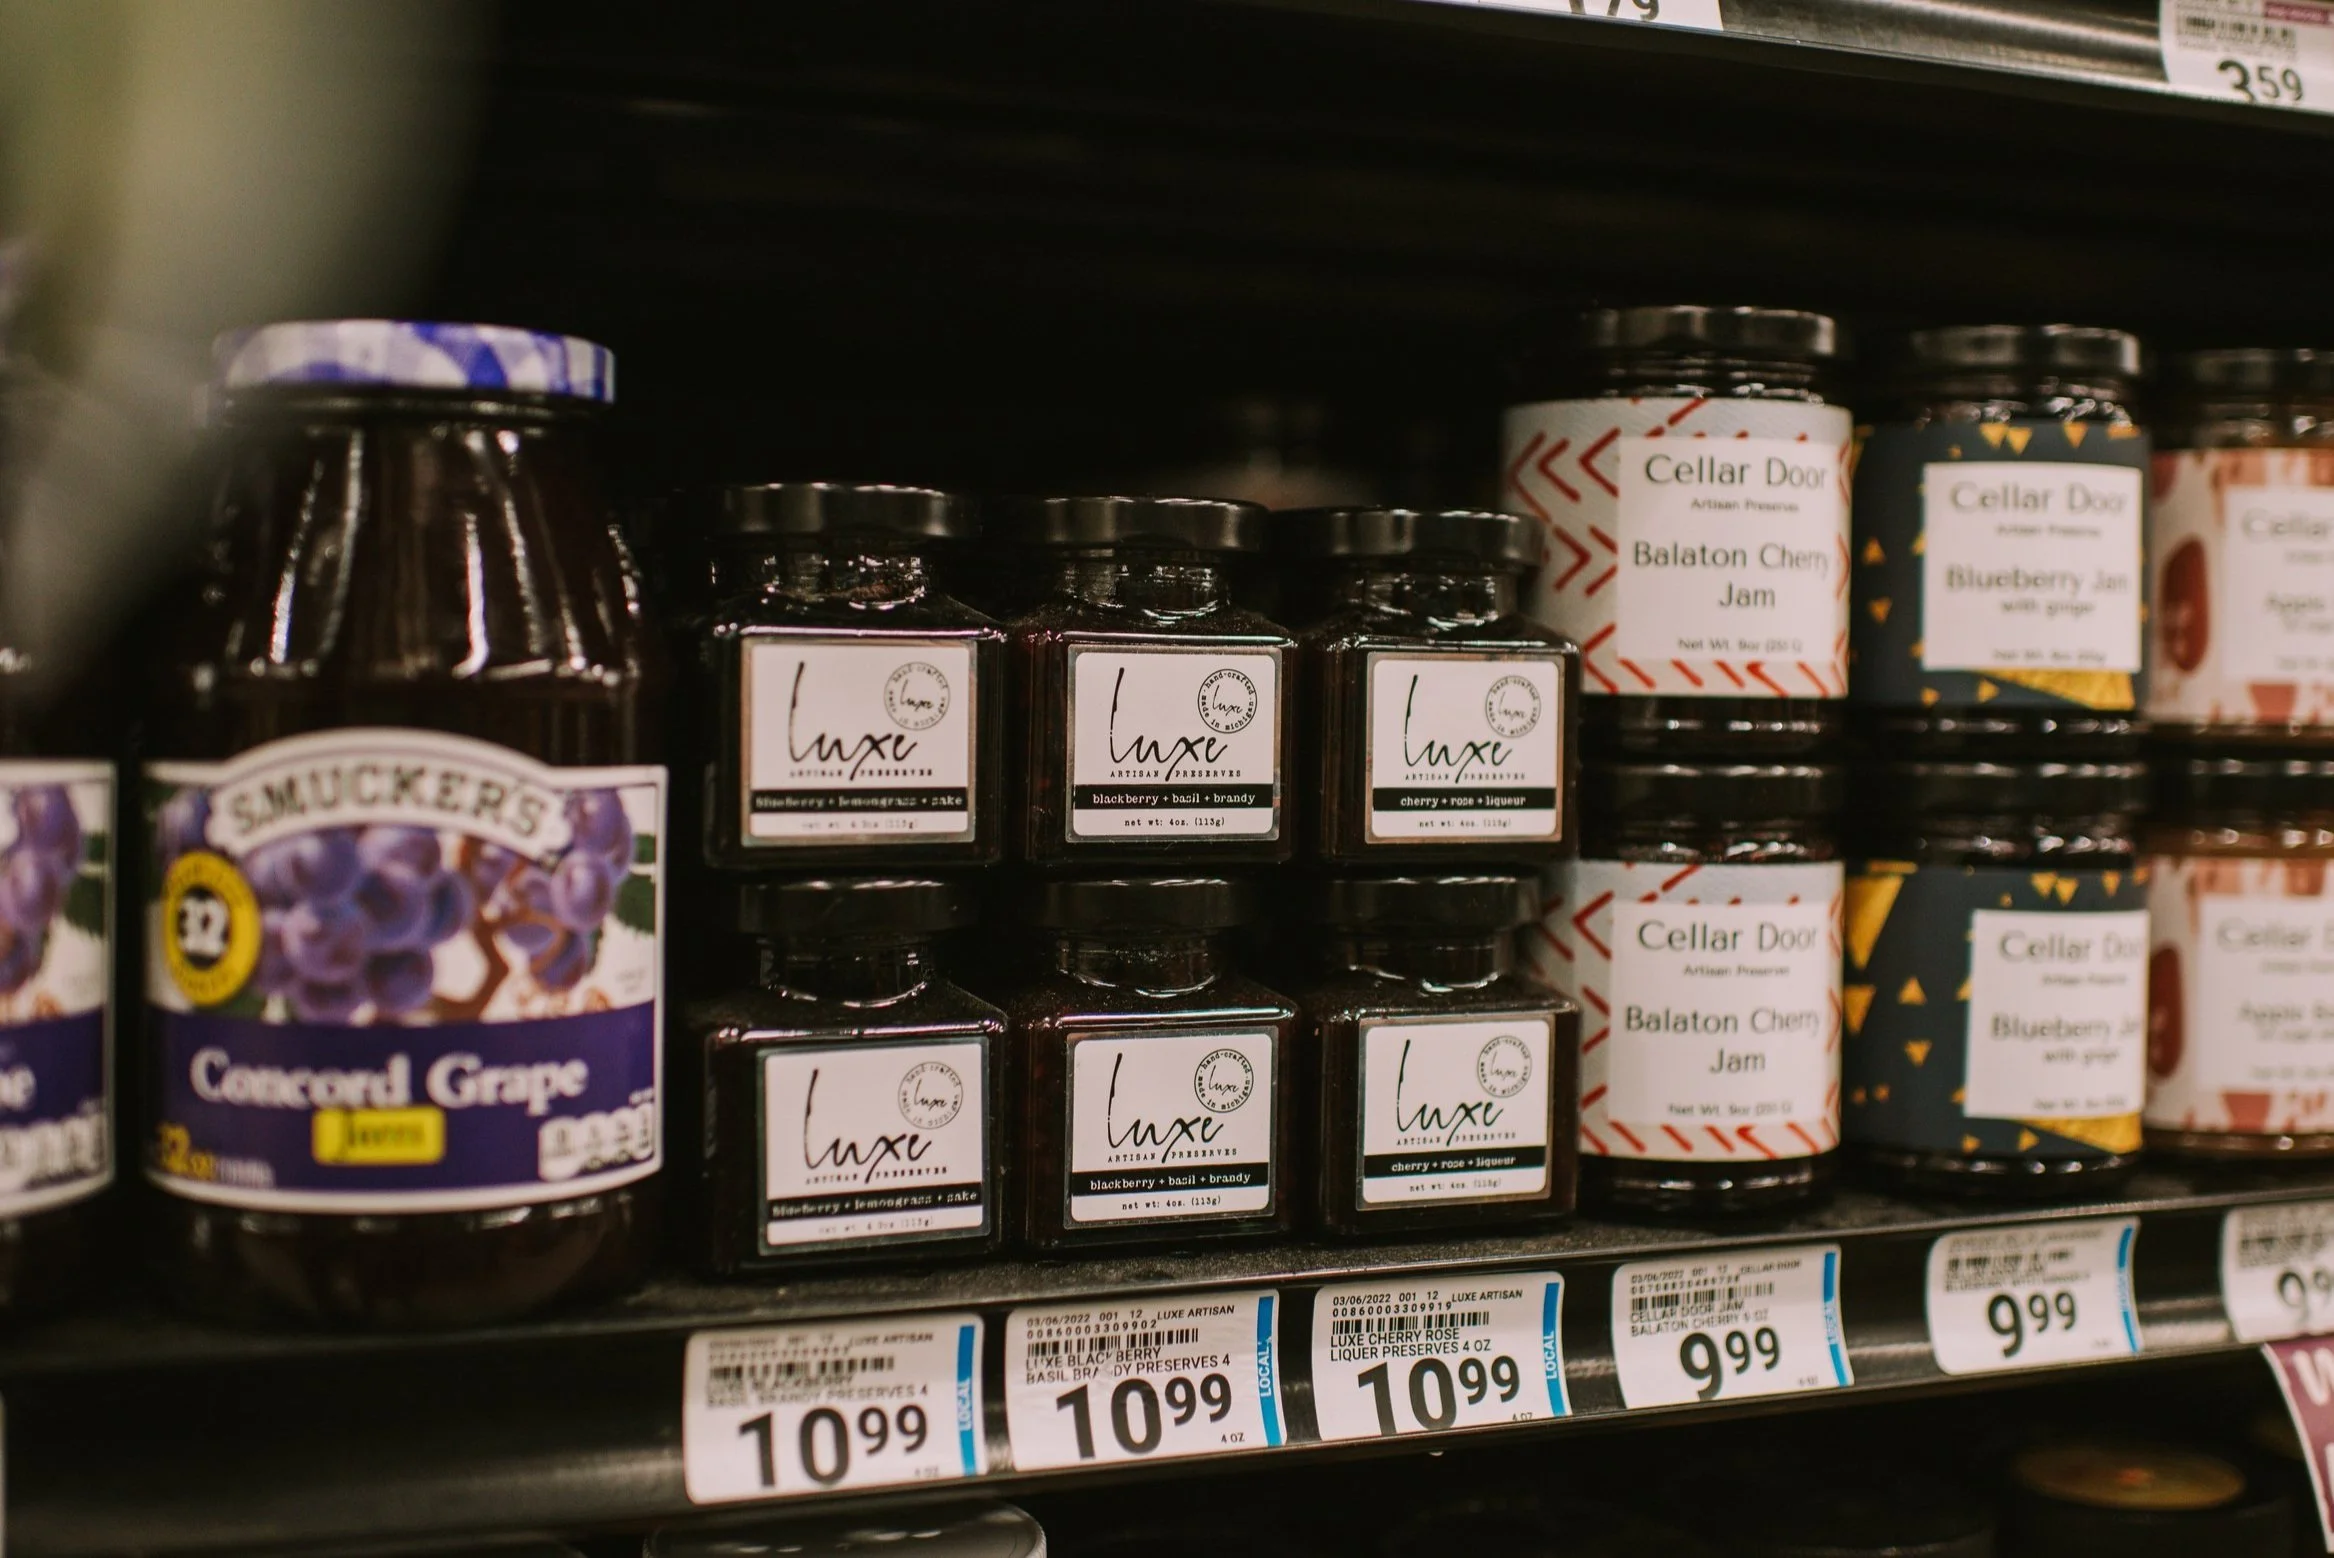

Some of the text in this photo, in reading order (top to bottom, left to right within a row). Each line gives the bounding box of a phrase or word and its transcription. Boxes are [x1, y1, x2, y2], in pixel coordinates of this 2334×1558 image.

[1645, 453, 1826, 488] Cellar Door
[1952, 481, 2053, 513] Cellar
[1634, 540, 1828, 579] Balaton Cherry
[1946, 565, 2082, 596] Blueberry
[1718, 581, 1775, 608] Jam
[1093, 794, 1159, 805] blackberry
[1172, 793, 1200, 803] basil
[1213, 793, 1255, 805] brandy
[1401, 797, 1439, 808] cherry
[1451, 797, 1474, 805] rose
[1486, 796, 1526, 807] liqueur
[1638, 920, 1817, 951] Cellar Door
[1999, 931, 2092, 963] Cellar
[1626, 1006, 1819, 1037] Balaton Cherry
[1709, 1049, 1765, 1074] Jam
[190, 1048, 589, 1116] Concord Grape
[1108, 1149, 1237, 1162] ARTISAN PRESERVES
[1392, 1162, 1429, 1172] cherry
[1441, 1160, 1464, 1168] rose
[1476, 1157, 1516, 1167] liqueur
[1090, 1179, 1155, 1190] blackberry
[1169, 1175, 1196, 1186] basil
[1209, 1173, 1251, 1184] brandy
[1333, 1290, 1523, 1305] 03/06/2022 001 12 LUXE ARTISAN
[1027, 1305, 1234, 1327] 03/06/2022 001 12 LUXE ARTISAN
[1632, 1310, 1677, 1323] CELLAR
[1632, 1321, 1688, 1336] BALATON
[1331, 1328, 1459, 1348] LUXE CHERRY ROSE
[1331, 1339, 1491, 1362] LIQUER PRESERVES 4 OZ
[1544, 1330, 1557, 1380] LOCAL
[1026, 1353, 1230, 1385] BASIL PRESERVES 4
[1257, 1350, 1271, 1397] LOCAL
[958, 1377, 972, 1431] LOCAL
[1231, 1432, 1245, 1442] OZ
